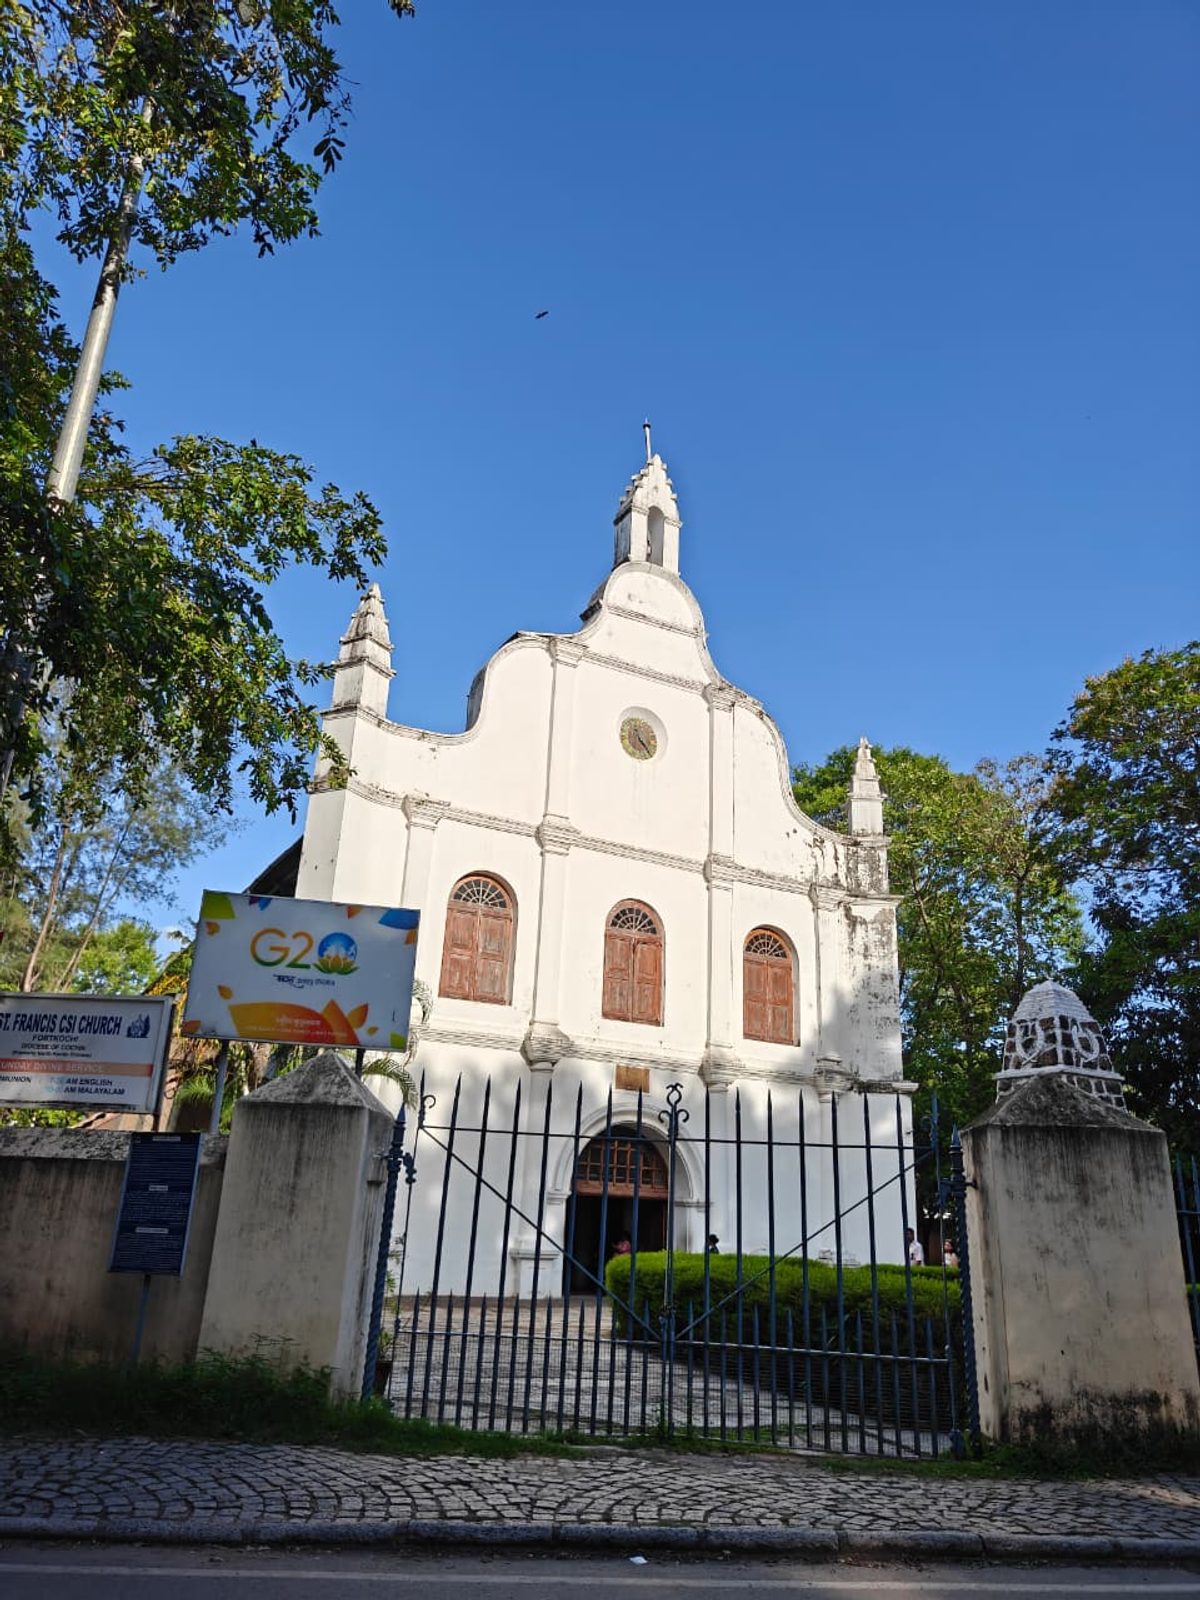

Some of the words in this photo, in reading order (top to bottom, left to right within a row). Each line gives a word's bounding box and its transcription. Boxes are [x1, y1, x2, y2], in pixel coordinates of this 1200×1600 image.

[250, 927, 360, 975] G20
[12, 1013, 58, 1033] FRANCIS
[59, 1014, 77, 1034] CSI
[78, 1015, 123, 1036] CHURCH
[0, 1061, 31, 1072] UNDAY
[65, 1077, 78, 1085] AM
[79, 1078, 113, 1086] ENGLISH
[78, 1086, 125, 1095] MALAYALAM
